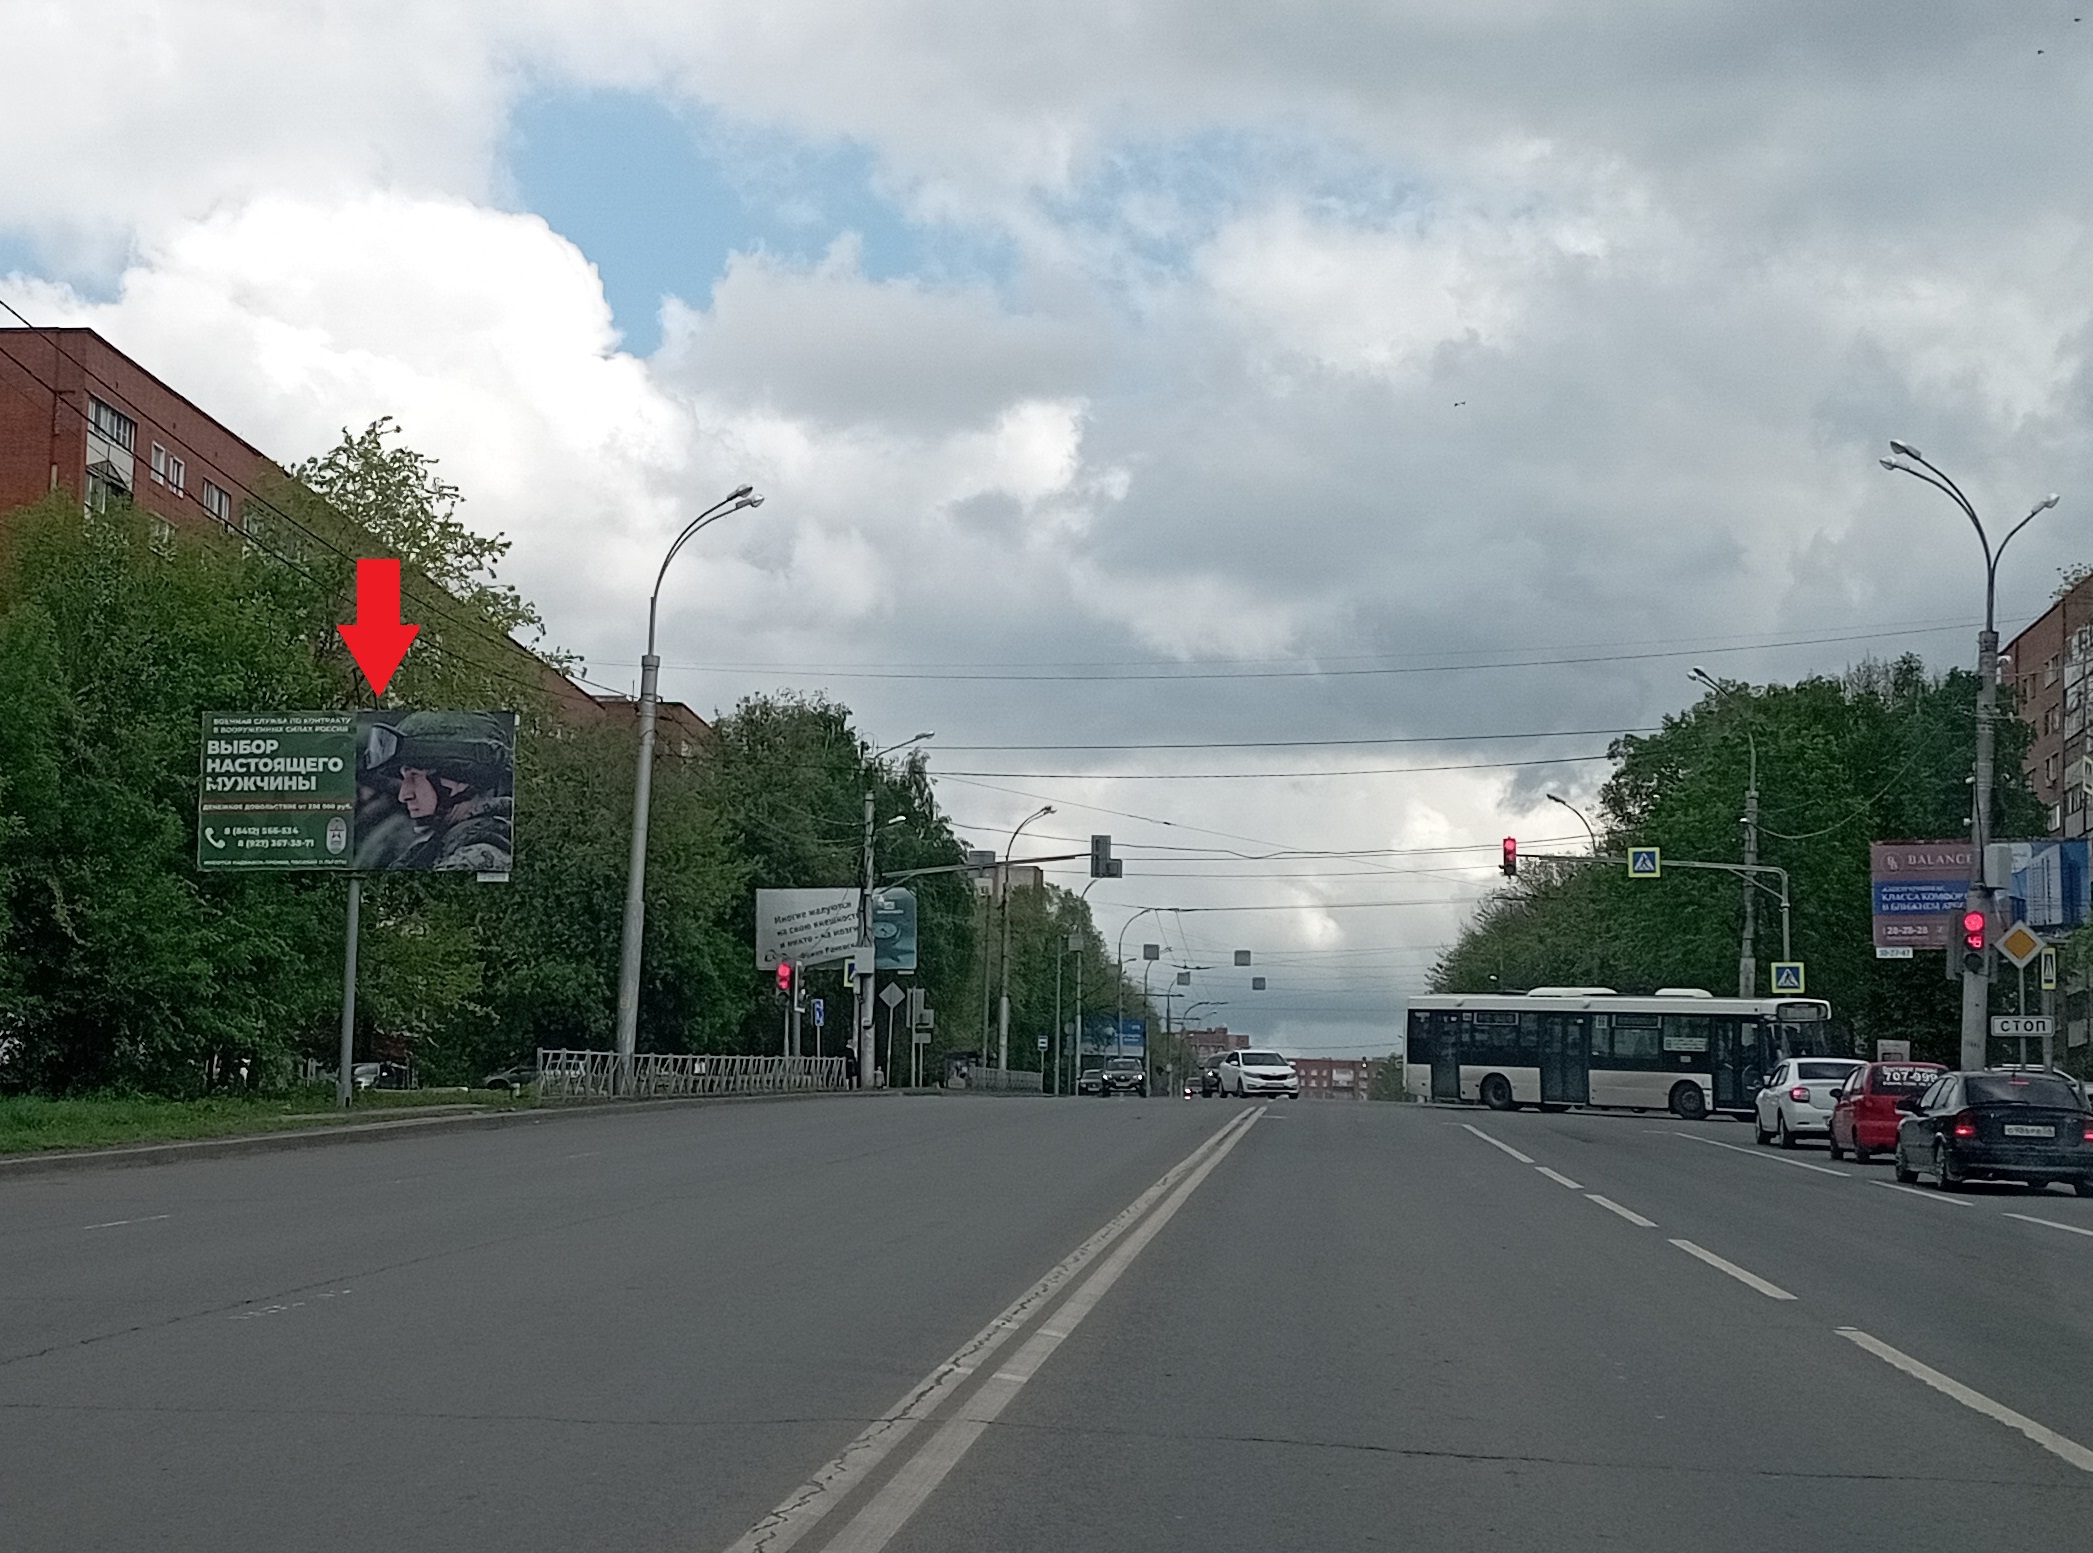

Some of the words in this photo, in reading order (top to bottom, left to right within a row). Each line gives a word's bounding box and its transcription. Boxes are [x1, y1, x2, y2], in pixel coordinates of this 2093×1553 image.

[207, 739, 279, 755] ВЫБОР
[206, 757, 344, 774] НАСТОЯЩЕГО
[205, 776, 317, 791] МУЖЧИНЫ
[223, 827, 231, 835] 8
[237, 839, 244, 847] 8
[774, 911, 807, 924] Многие
[2000, 1020, 2046, 1032] СТОП
